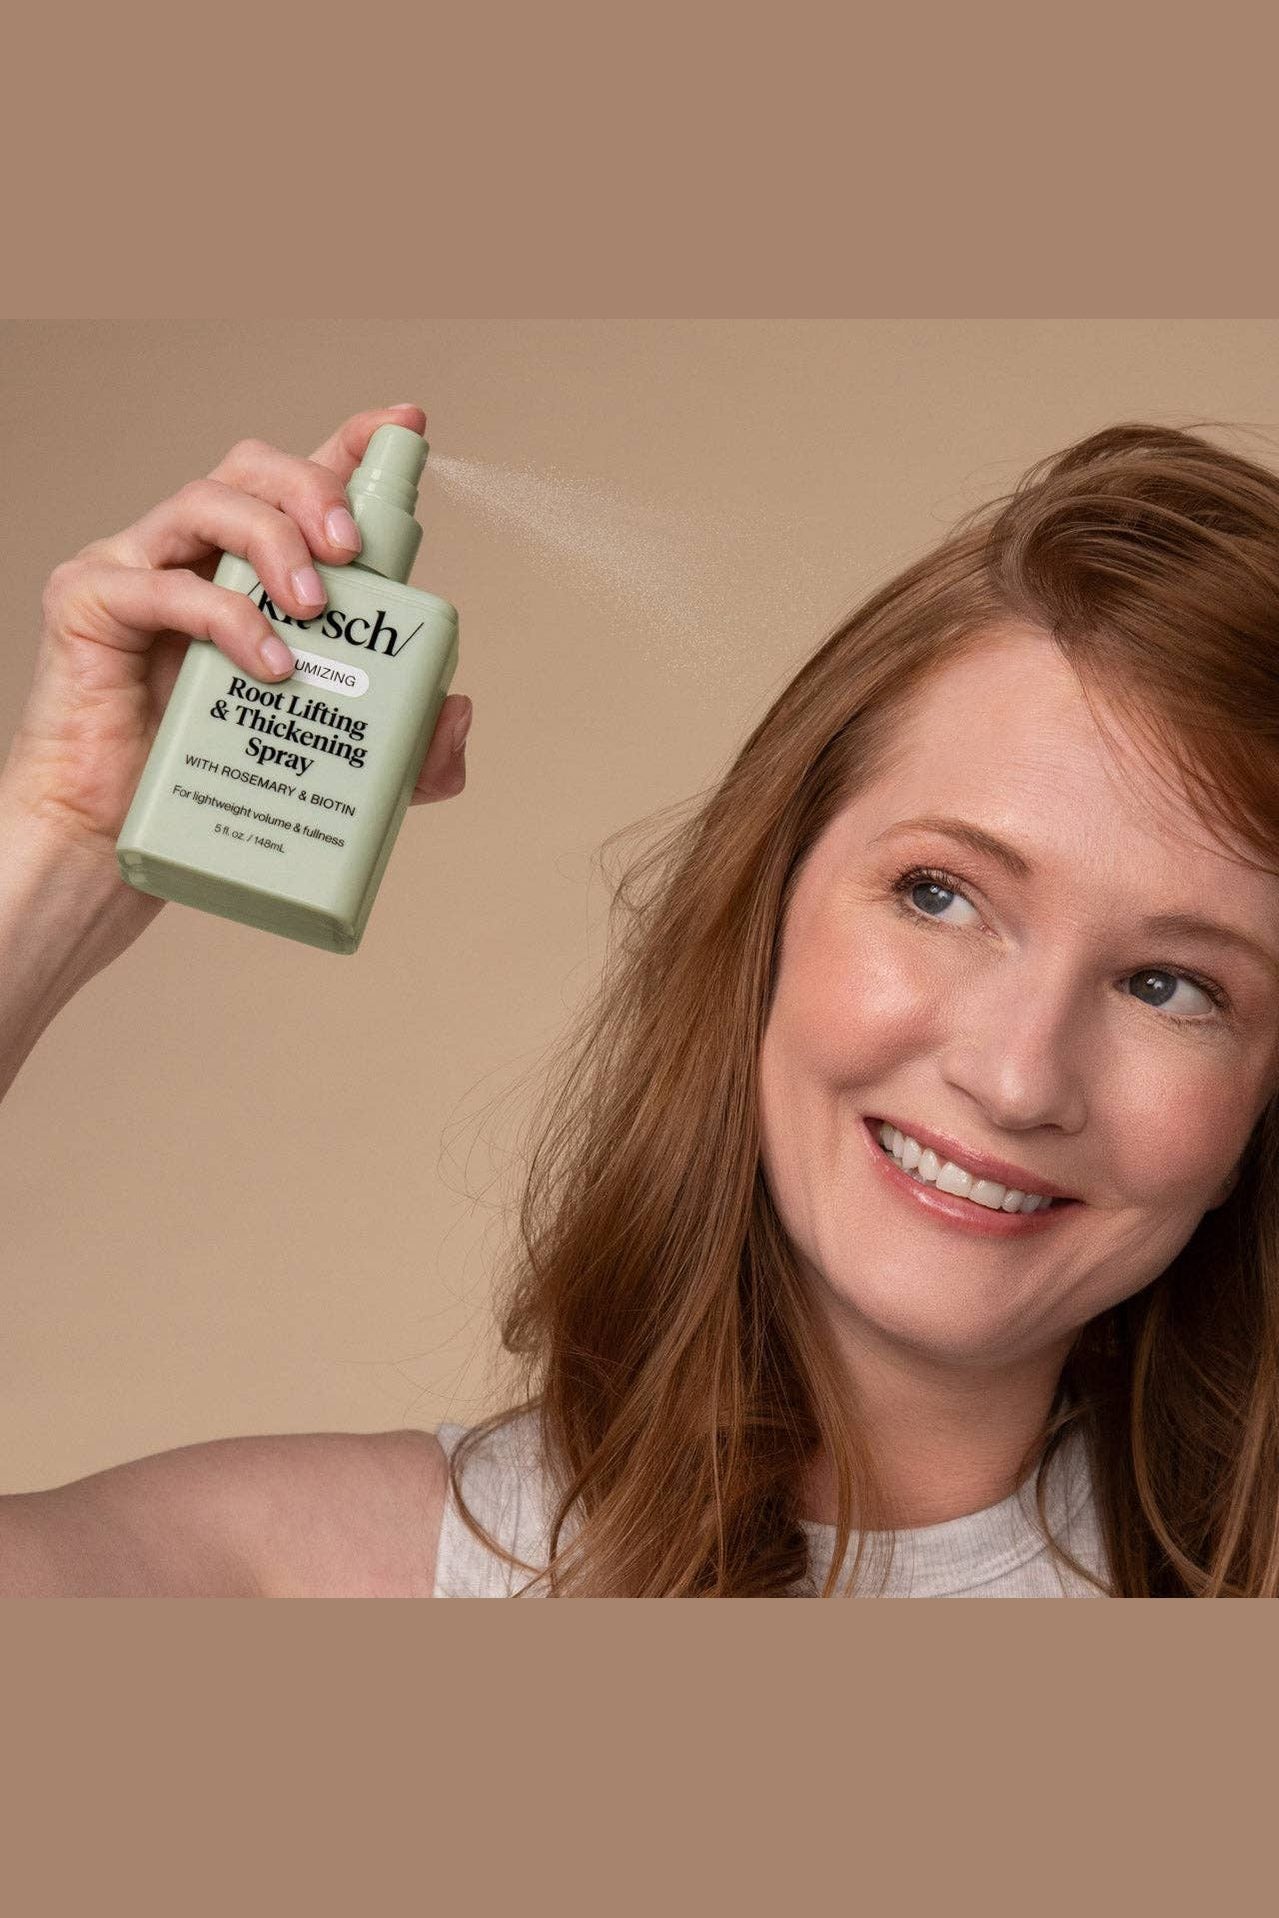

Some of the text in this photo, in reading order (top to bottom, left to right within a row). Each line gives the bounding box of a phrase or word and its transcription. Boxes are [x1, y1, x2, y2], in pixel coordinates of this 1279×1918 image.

[295, 659, 357, 688] UMIZING
[210, 700, 368, 769] & Thickening
[227, 676, 369, 741] Root Lifting
[185, 754, 356, 817] WITH ROSEMARY & BIOTIN
[245, 737, 315, 777] Spray
[172, 784, 346, 848] For lightweight volume & fullness
[214, 823, 222, 834] 5
[254, 836, 286, 854] 148mL
